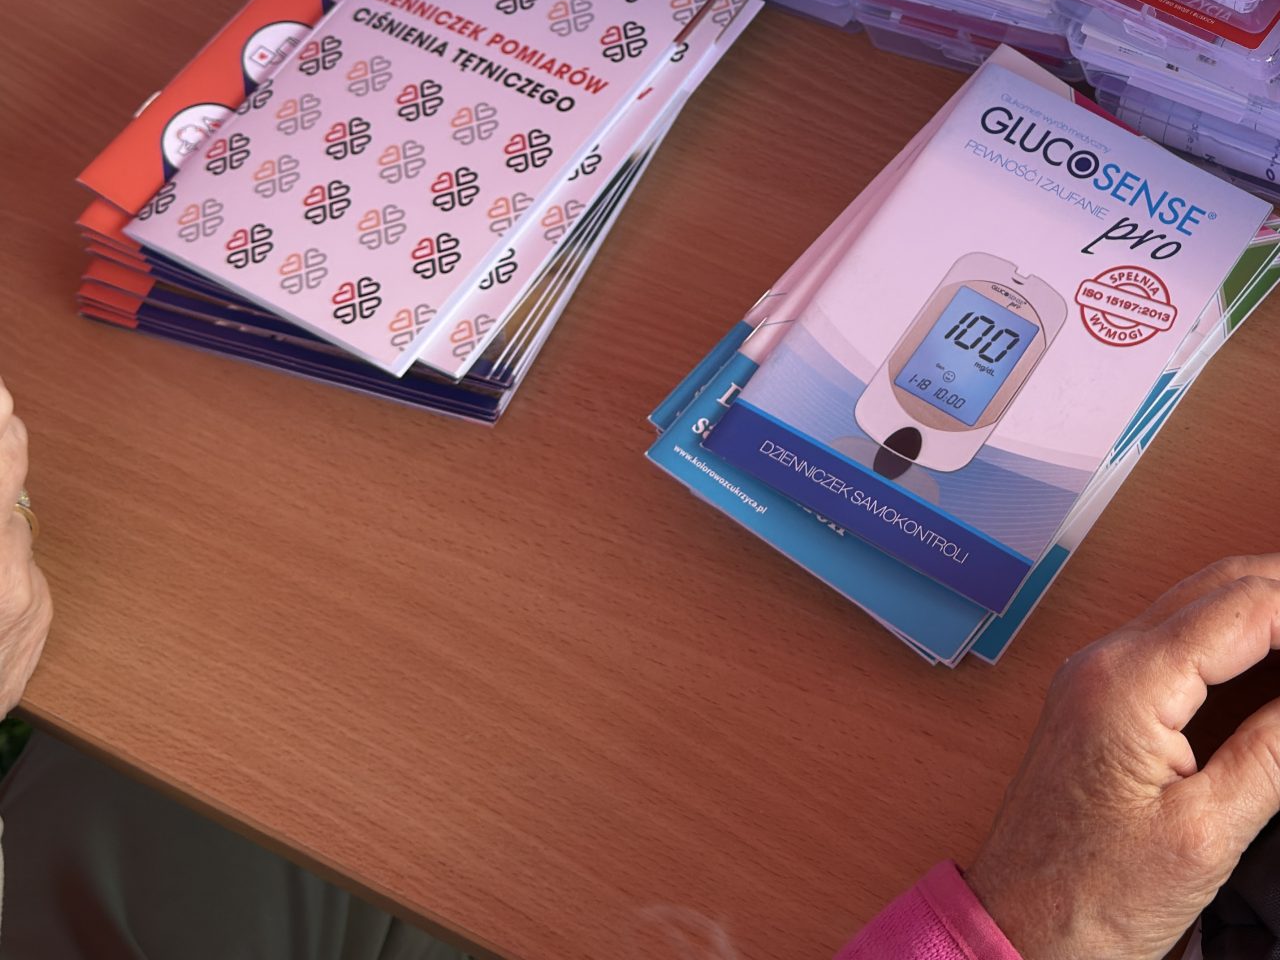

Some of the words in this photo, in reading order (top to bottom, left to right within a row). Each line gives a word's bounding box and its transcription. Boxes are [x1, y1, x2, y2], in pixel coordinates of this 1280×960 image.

[353, 7, 449, 58] CIŚNIENIA
[452, 47, 575, 112] TĘTNICZEGO
[486, 33, 609, 95] POMIARÓW
[964, 139, 1038, 183] PEWNOŚĆ
[1040, 176, 1111, 221] ZAUFANIE
[1081, 217, 1182, 260] pro
[1082, 287, 1103, 301] ISO
[1106, 295, 1171, 322] 15197:2013
[1109, 271, 1160, 296] SPEŁNIA
[944, 312, 1020, 363] 100
[1090, 313, 1143, 341] WYMOGI
[974, 361, 995, 377] mg/dL
[673, 445, 768, 514] www.kolorowozcukrzyca.pl
[759, 440, 850, 500] DZIENNICZEK
[850, 490, 970, 567] SAMOKONTROLI
